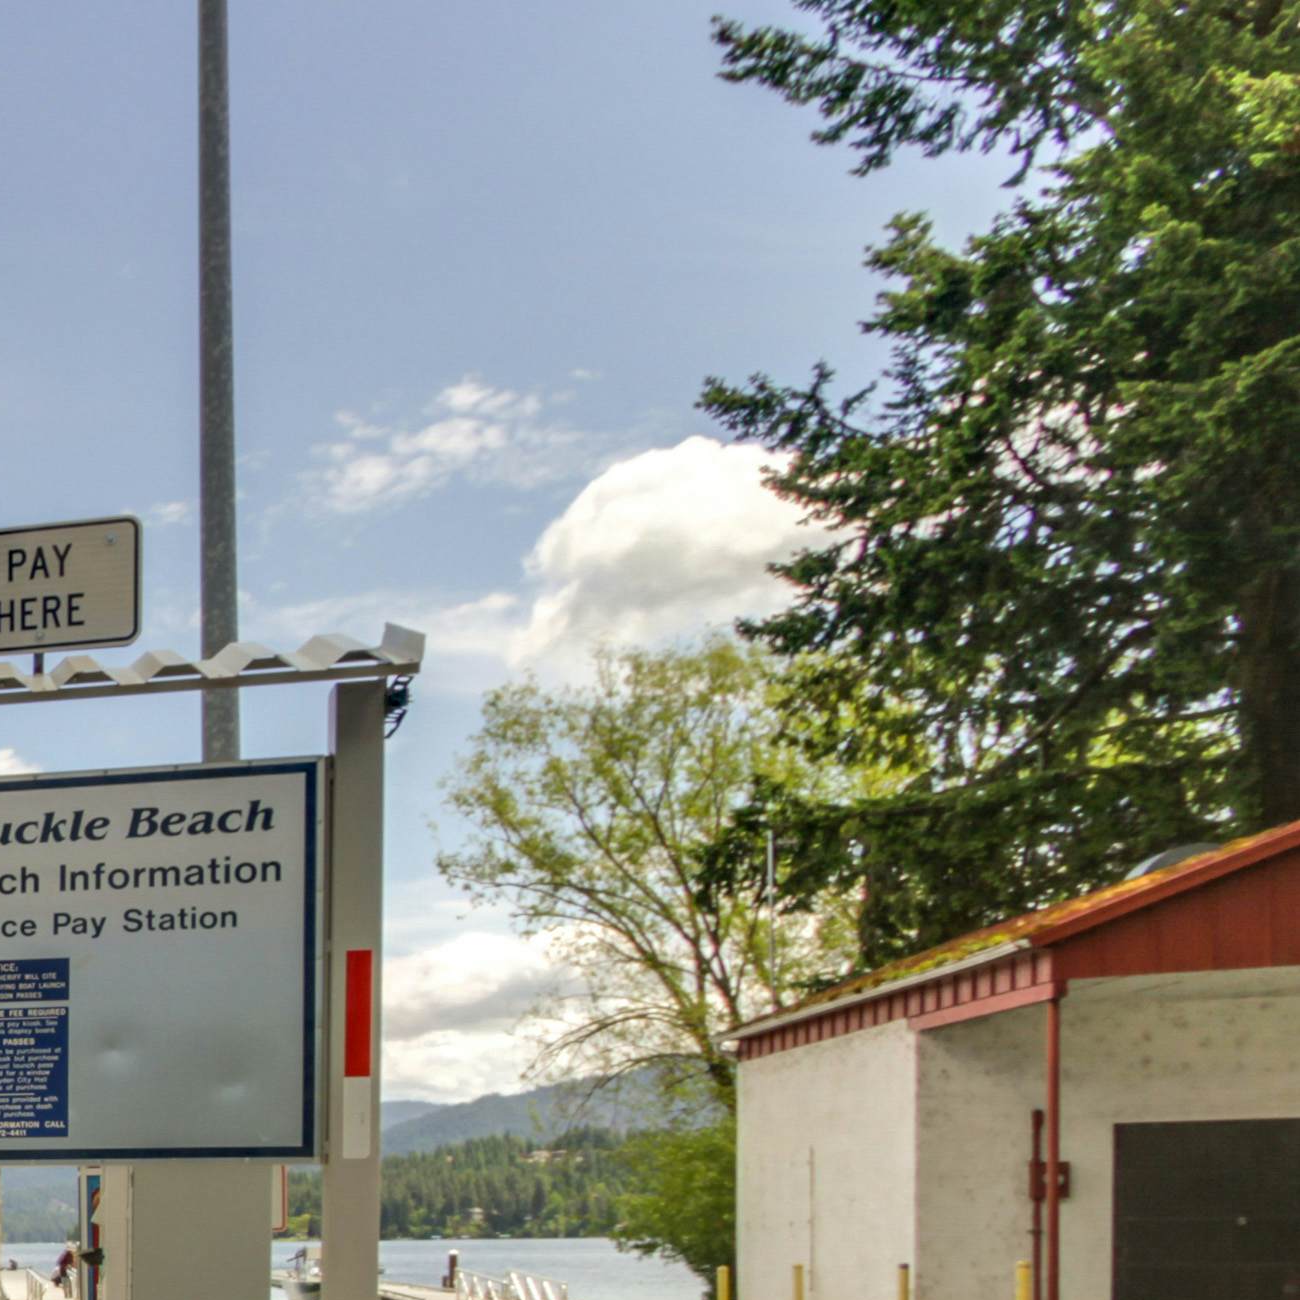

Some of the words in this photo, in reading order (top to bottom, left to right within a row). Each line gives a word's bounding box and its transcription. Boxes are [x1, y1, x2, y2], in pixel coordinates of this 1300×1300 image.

[8, 543, 72, 582] PAY
[125, 800, 275, 839] Beach
[59, 856, 282, 892] Information
[52, 912, 106, 939] Pay
[122, 907, 238, 933] Station
[28, 1008, 66, 1016] REQUIRED
[3, 1038, 35, 1046] PASSES
[45, 1120, 65, 1128] CALL
